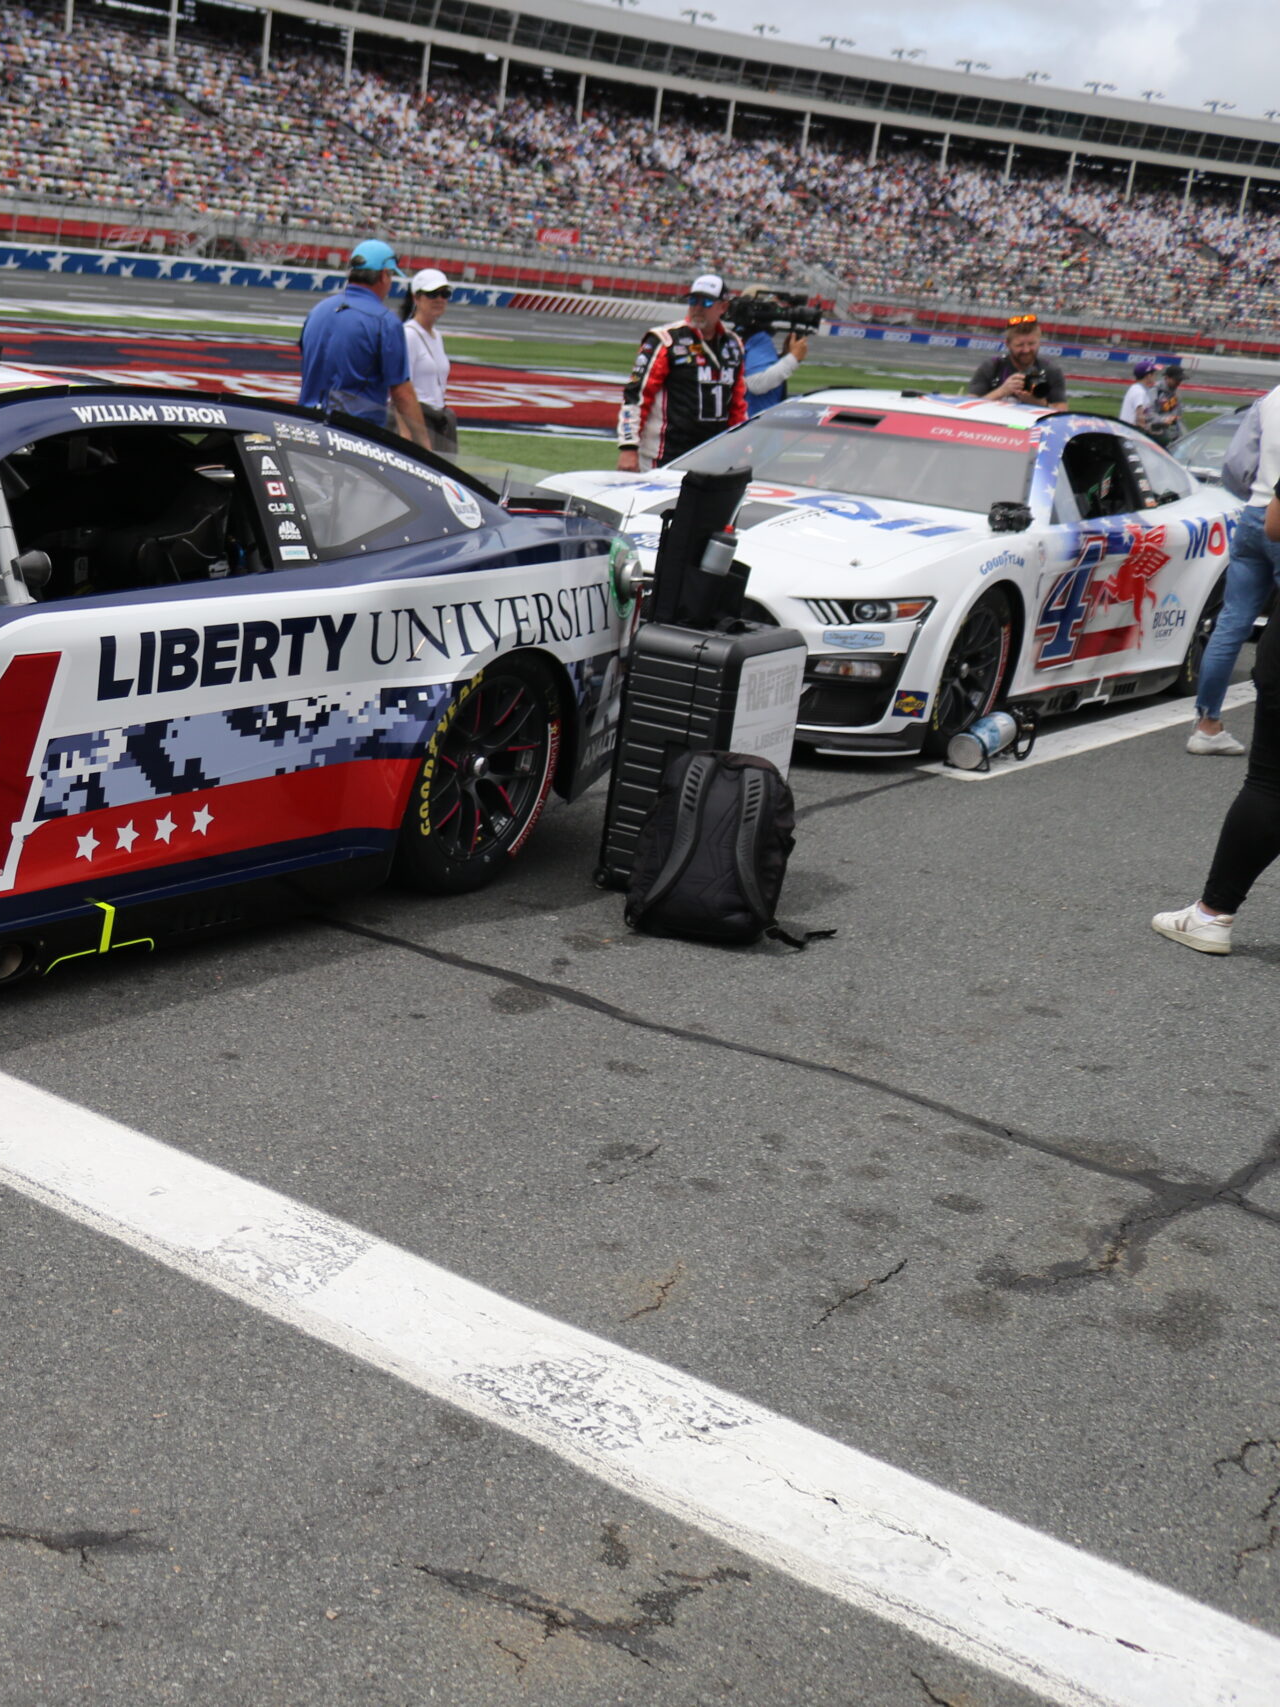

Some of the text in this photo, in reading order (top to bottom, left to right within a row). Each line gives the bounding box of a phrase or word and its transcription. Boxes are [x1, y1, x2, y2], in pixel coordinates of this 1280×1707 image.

[71, 405, 227, 425] WILLIAM BYRON
[930, 426, 1024, 447] CPL PATINO IV
[980, 551, 1025, 575] GOODYEAR
[1036, 536, 1107, 672] 4
[1152, 609, 1187, 630] BUSCH
[97, 580, 612, 700] LIBERTY UNIVERSITY
[580, 728, 617, 771] AXALT
